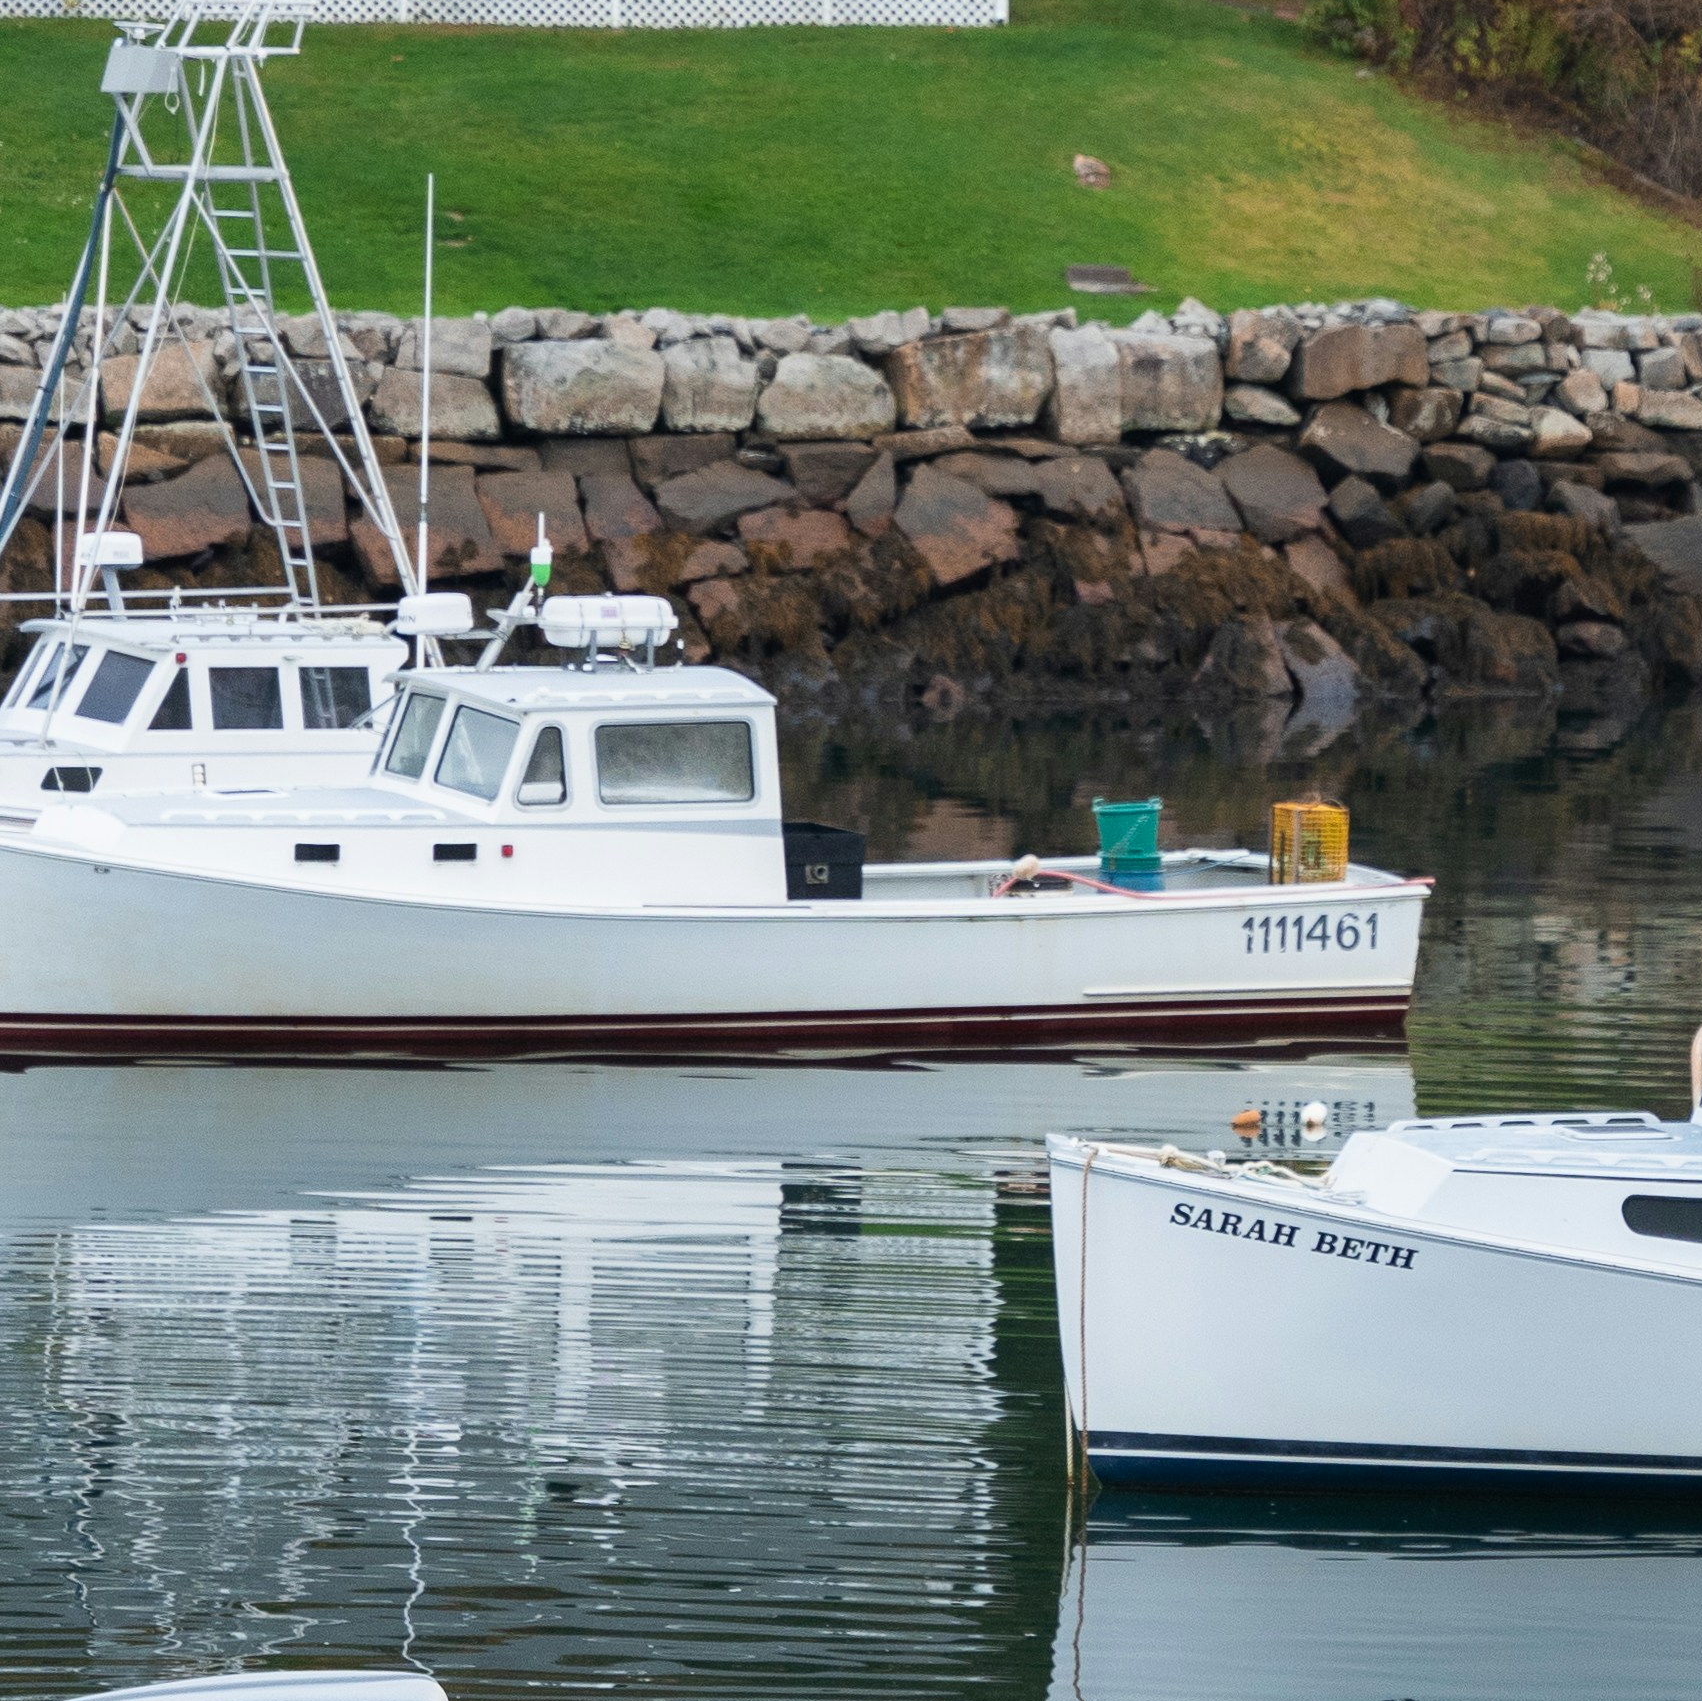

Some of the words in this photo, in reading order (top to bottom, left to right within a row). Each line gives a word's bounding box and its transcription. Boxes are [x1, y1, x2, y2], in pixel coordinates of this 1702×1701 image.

[1242, 912, 1379, 954] 1111461
[1169, 1202, 1301, 1248] SARAH
[1311, 1231, 1419, 1270] BETH
